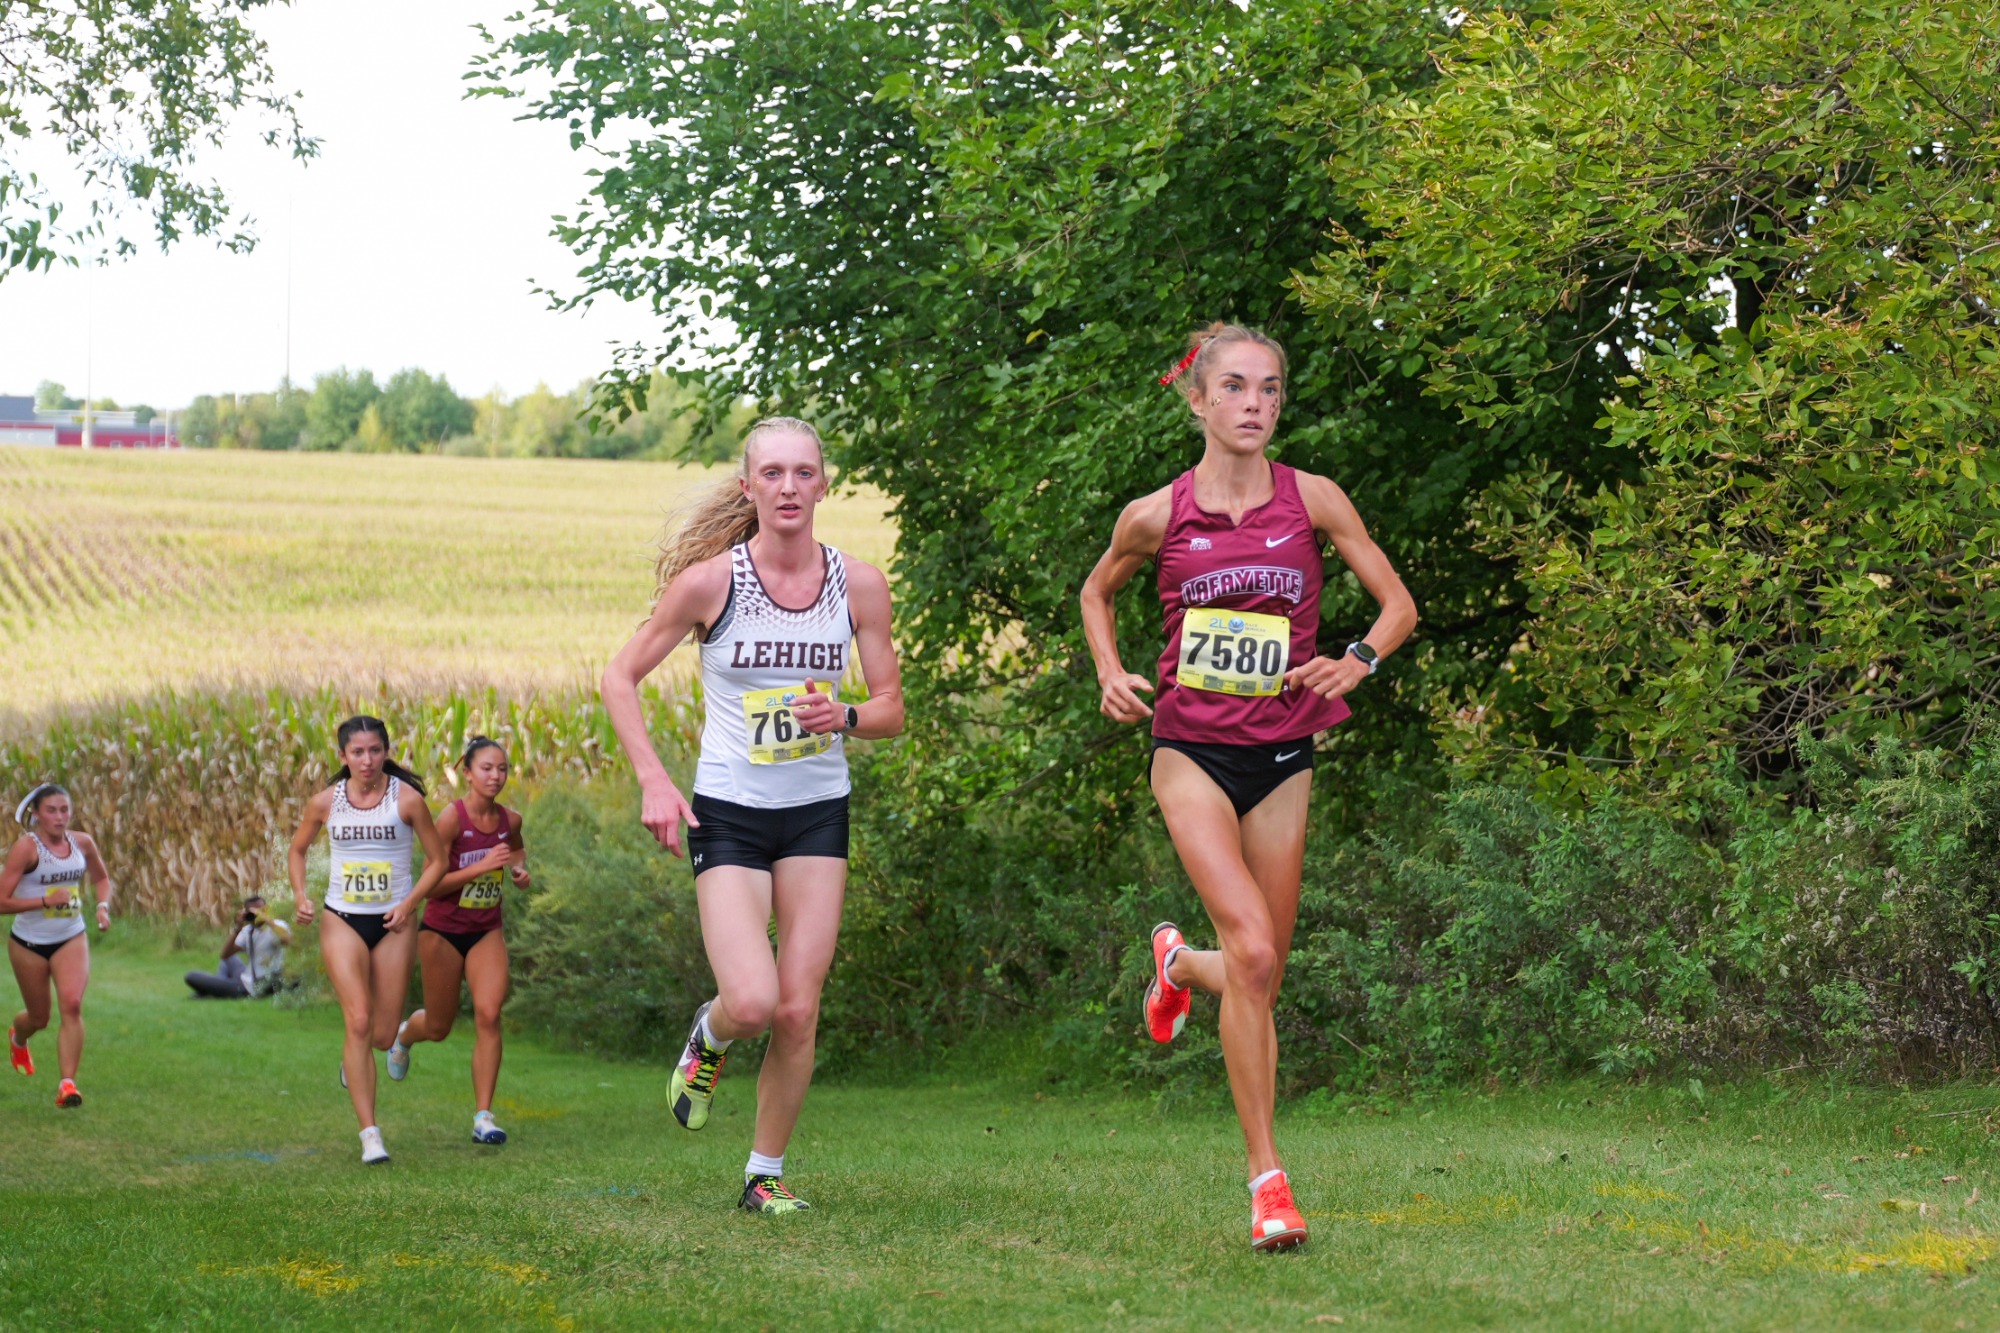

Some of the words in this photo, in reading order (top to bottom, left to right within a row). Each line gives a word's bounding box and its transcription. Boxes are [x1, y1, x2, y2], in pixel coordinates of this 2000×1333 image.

[1181, 566, 1302, 605] LAFAYETTE
[1209, 617, 1228, 629] 2L
[731, 641, 844, 671] LEHIGH
[1186, 631, 1282, 677] 7580
[766, 697, 782, 707] 2L
[751, 709, 821, 746] 76
[332, 825, 396, 841] LEHIGH
[343, 873, 388, 892] 7619
[464, 881, 501, 899] 7585
